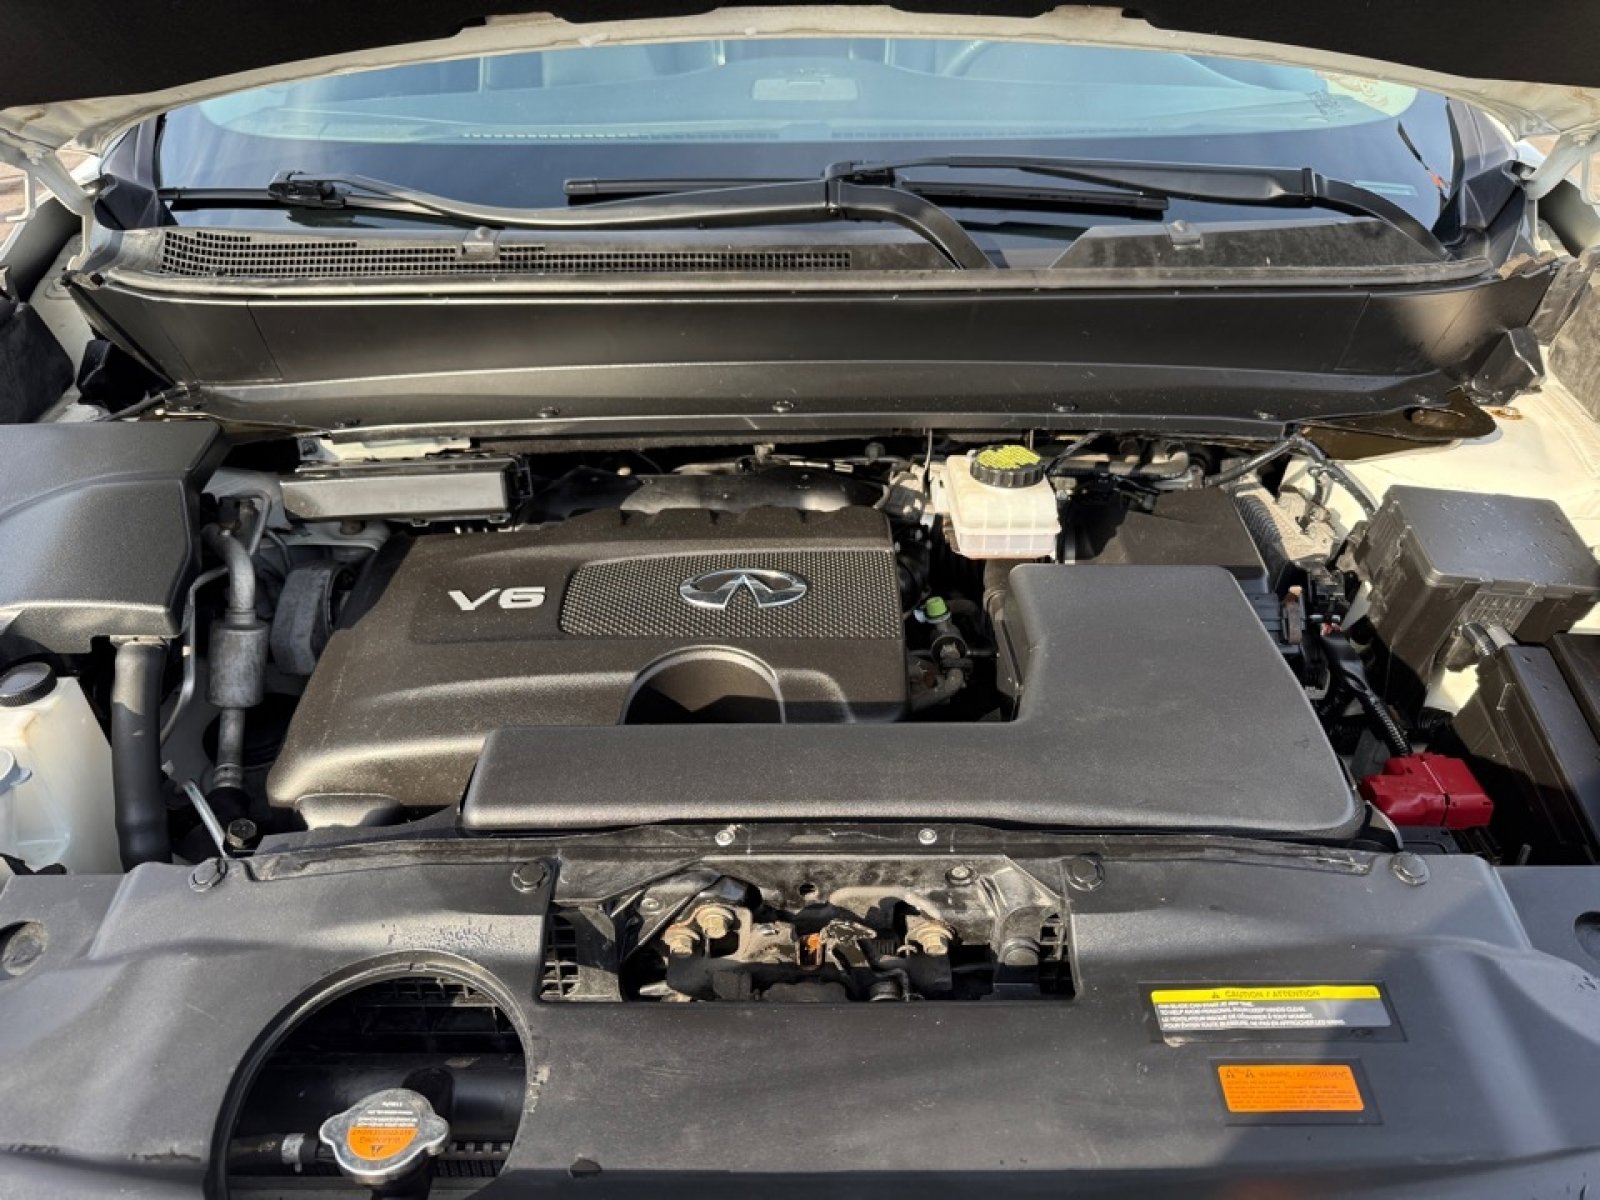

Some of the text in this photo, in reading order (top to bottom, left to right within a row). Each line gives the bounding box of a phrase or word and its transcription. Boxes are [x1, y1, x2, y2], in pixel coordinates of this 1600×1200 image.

[448, 586, 546, 611] V6
[1225, 990, 1263, 999] CAUTION
[1273, 989, 1321, 998] ATTENTION
